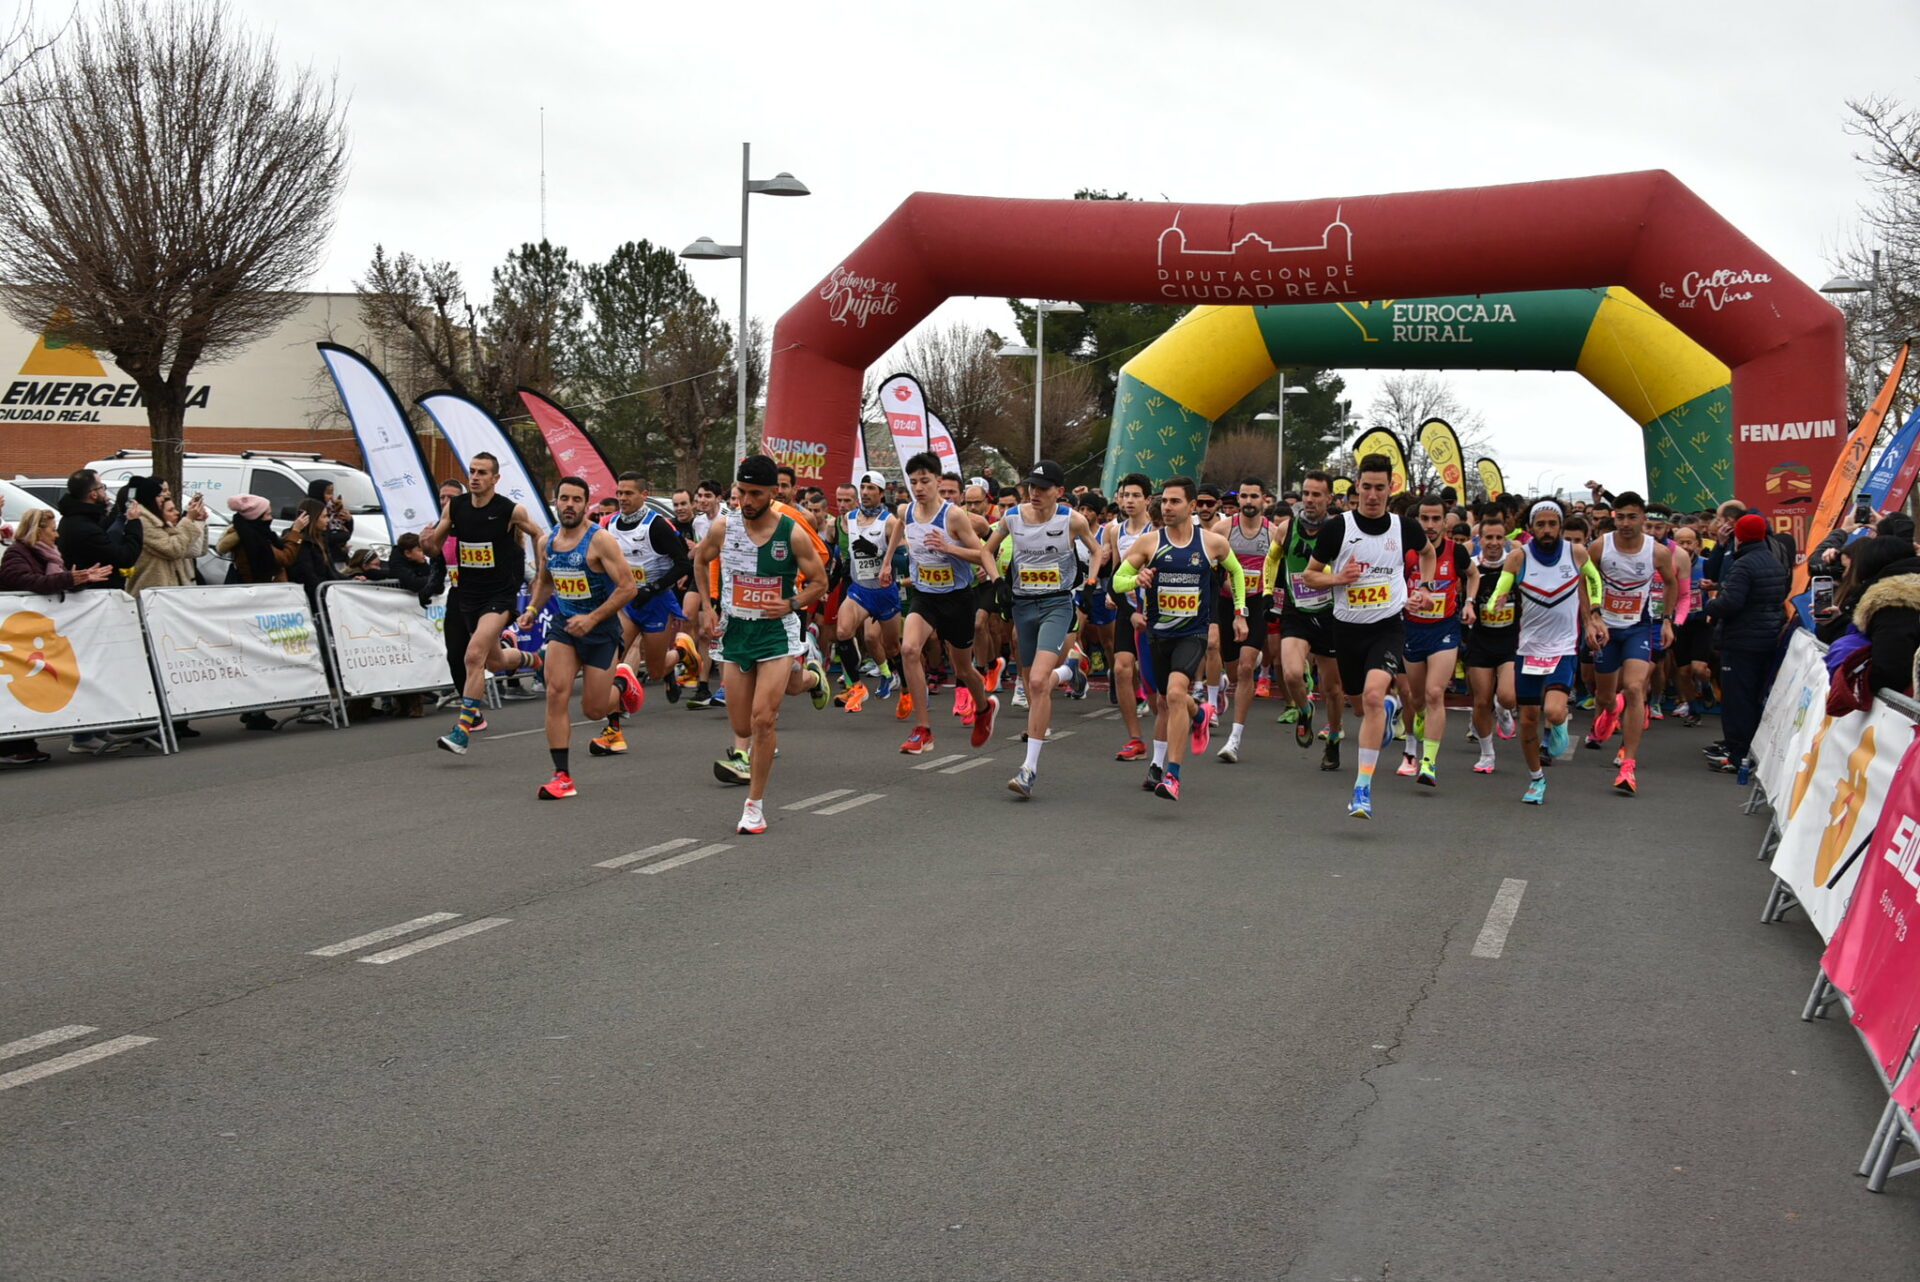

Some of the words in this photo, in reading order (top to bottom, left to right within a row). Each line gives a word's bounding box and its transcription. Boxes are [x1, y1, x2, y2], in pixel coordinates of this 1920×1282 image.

[1158, 267, 1311, 282] DIPUTACIÓN
[1326, 265, 1354, 277] DE
[820, 266, 876, 300] Sabores
[881, 282, 897, 294] del
[1161, 283, 1274, 298] CIUDAD
[1285, 281, 1357, 297] REAL
[1659, 282, 1675, 299] La
[1682, 269, 1772, 299] Cultura
[830, 287, 900, 328] Quijote
[1679, 299, 1696, 309] del
[1703, 287, 1753, 311] Vino
[1393, 304, 1516, 322] EUROCAJA
[1393, 325, 1473, 342] RURAL
[3, 381, 210, 408] EMERGENIA
[0, 409, 55, 421] CIUDAD
[57, 411, 100, 422] REAL
[893, 419, 917, 431] 01:40
[1740, 419, 1836, 442] FENAVIN
[767, 436, 827, 456] TURISMO
[774, 450, 826, 468] CIUDAD
[788, 464, 823, 480] EAL
[461, 549, 491, 562] 5183
[1020, 571, 1057, 582] 5362
[1244, 575, 1258, 587] 95
[555, 579, 587, 592] 5476
[742, 589, 770, 602] 260
[1159, 595, 1196, 609] 5066
[1347, 587, 1388, 603] 5424
[1611, 600, 1633, 609] 872
[255, 612, 304, 630] TURISMO
[231, 655, 244, 664] DE
[347, 655, 386, 670] CIUDAD
[390, 652, 414, 664] REAL
[170, 668, 217, 685] CIUDAD
[219, 665, 248, 680] REAL
